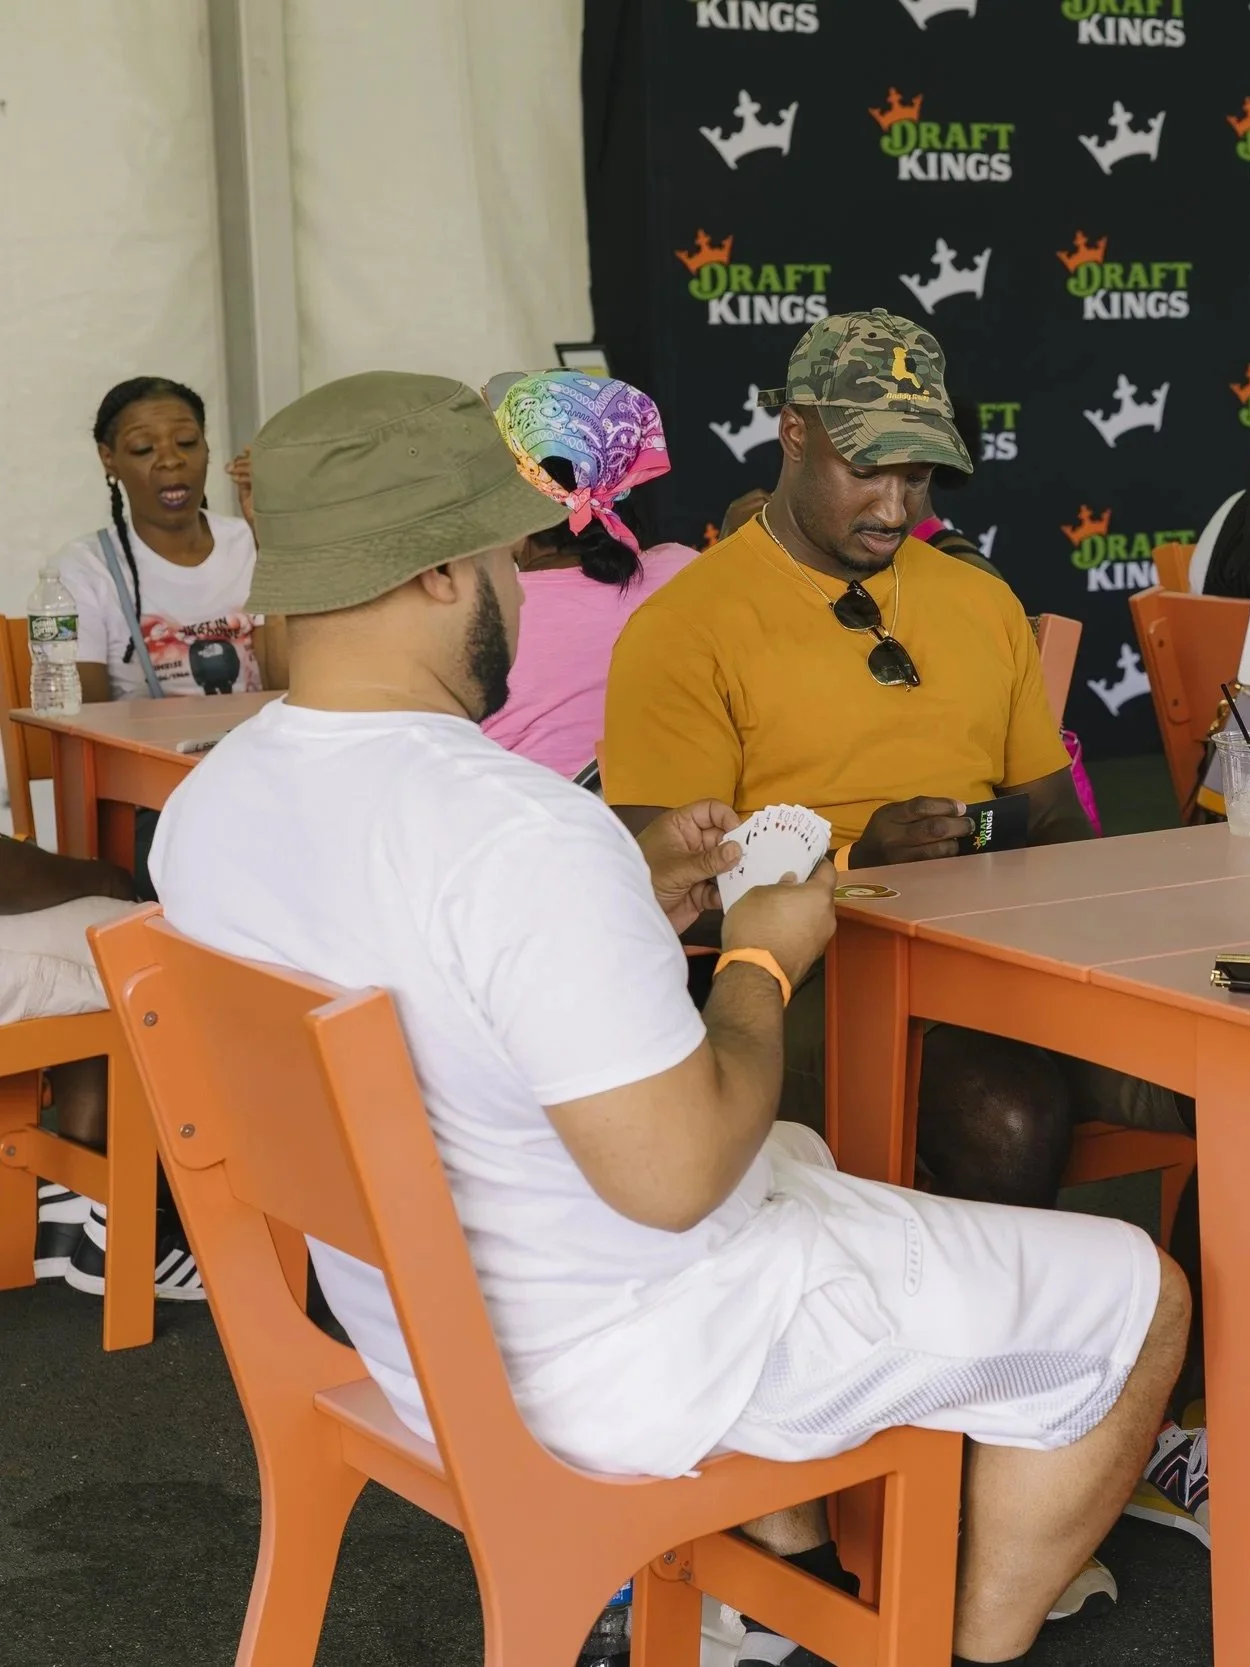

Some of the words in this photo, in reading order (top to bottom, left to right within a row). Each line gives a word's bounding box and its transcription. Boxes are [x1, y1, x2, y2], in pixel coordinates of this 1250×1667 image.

[696, 1, 820, 33] KINGS
[1077, 14, 1186, 47] KINGS
[880, 118, 1015, 157] DRAFT
[897, 149, 1013, 182] KINGS
[689, 261, 832, 301] DRAFT
[1067, 260, 1193, 298] DRAFT
[707, 292, 829, 325] KINGS
[1082, 289, 1190, 320] KINGS
[1086, 559, 1160, 592] KIN
[985, 810, 994, 841] KINGS
